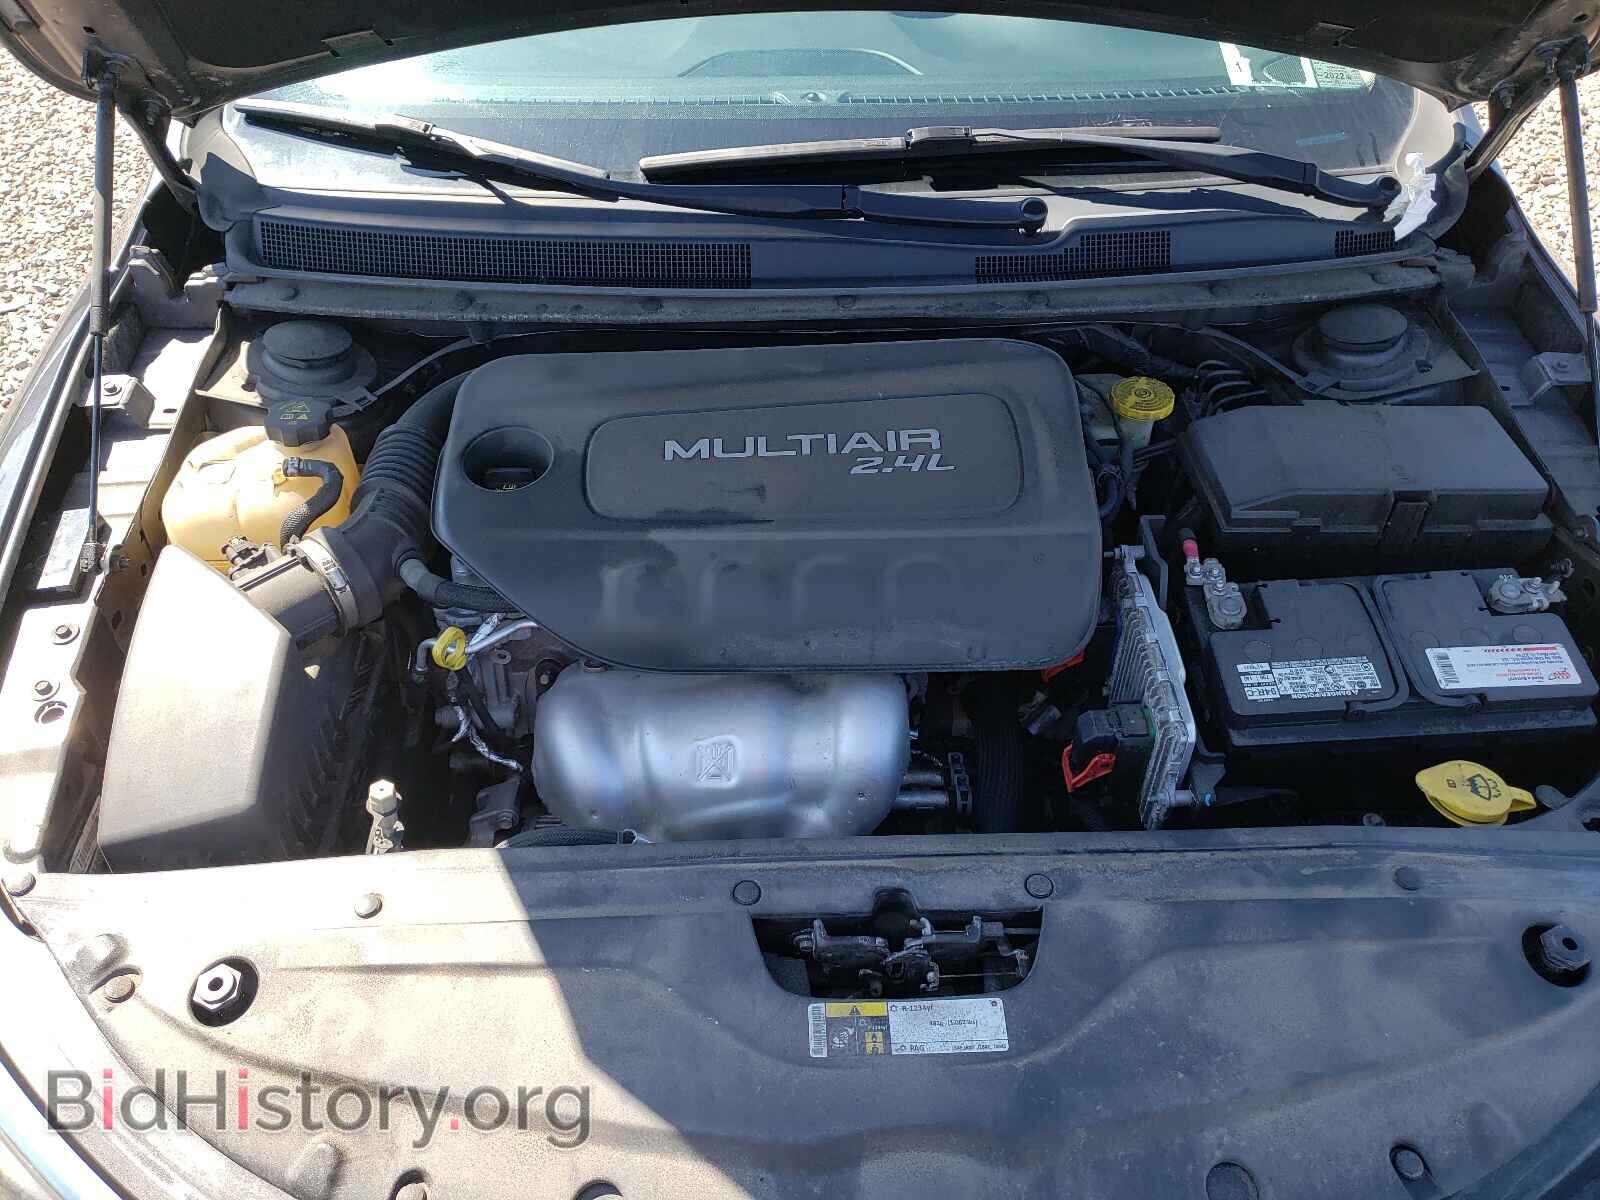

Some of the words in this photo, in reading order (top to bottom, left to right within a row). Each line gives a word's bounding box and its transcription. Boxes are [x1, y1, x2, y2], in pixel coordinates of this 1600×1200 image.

[1323, 71, 1346, 80] 2022
[664, 428, 942, 461] MULTIAIR
[850, 453, 956, 474] 2.4L
